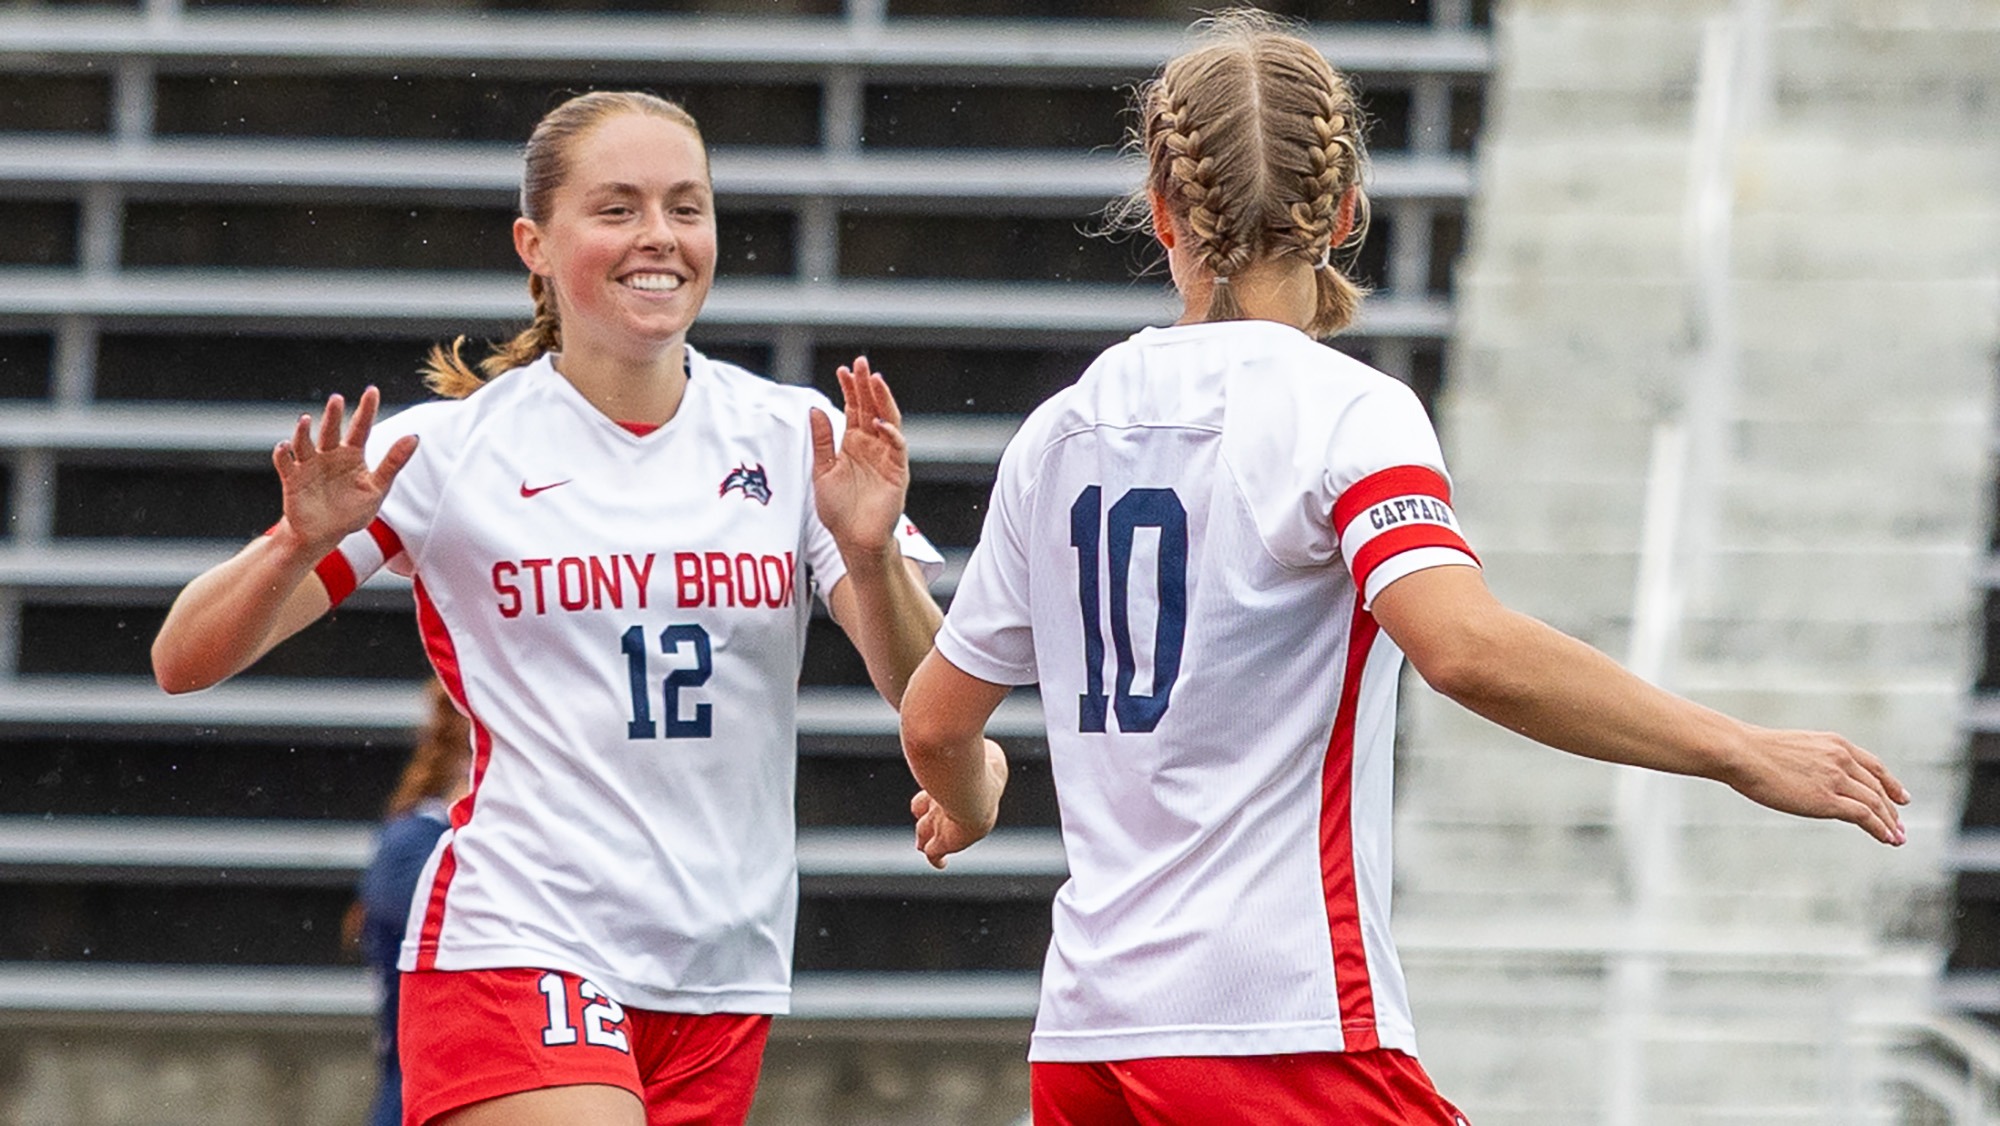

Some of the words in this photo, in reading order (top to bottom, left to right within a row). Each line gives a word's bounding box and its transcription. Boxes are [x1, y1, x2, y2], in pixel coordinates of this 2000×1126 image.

[1369, 498, 1451, 530] CAPTAIN
[491, 553, 656, 618] STONY
[1069, 484, 1188, 733] 10
[621, 624, 713, 739] 12
[538, 971, 630, 1055] 12
